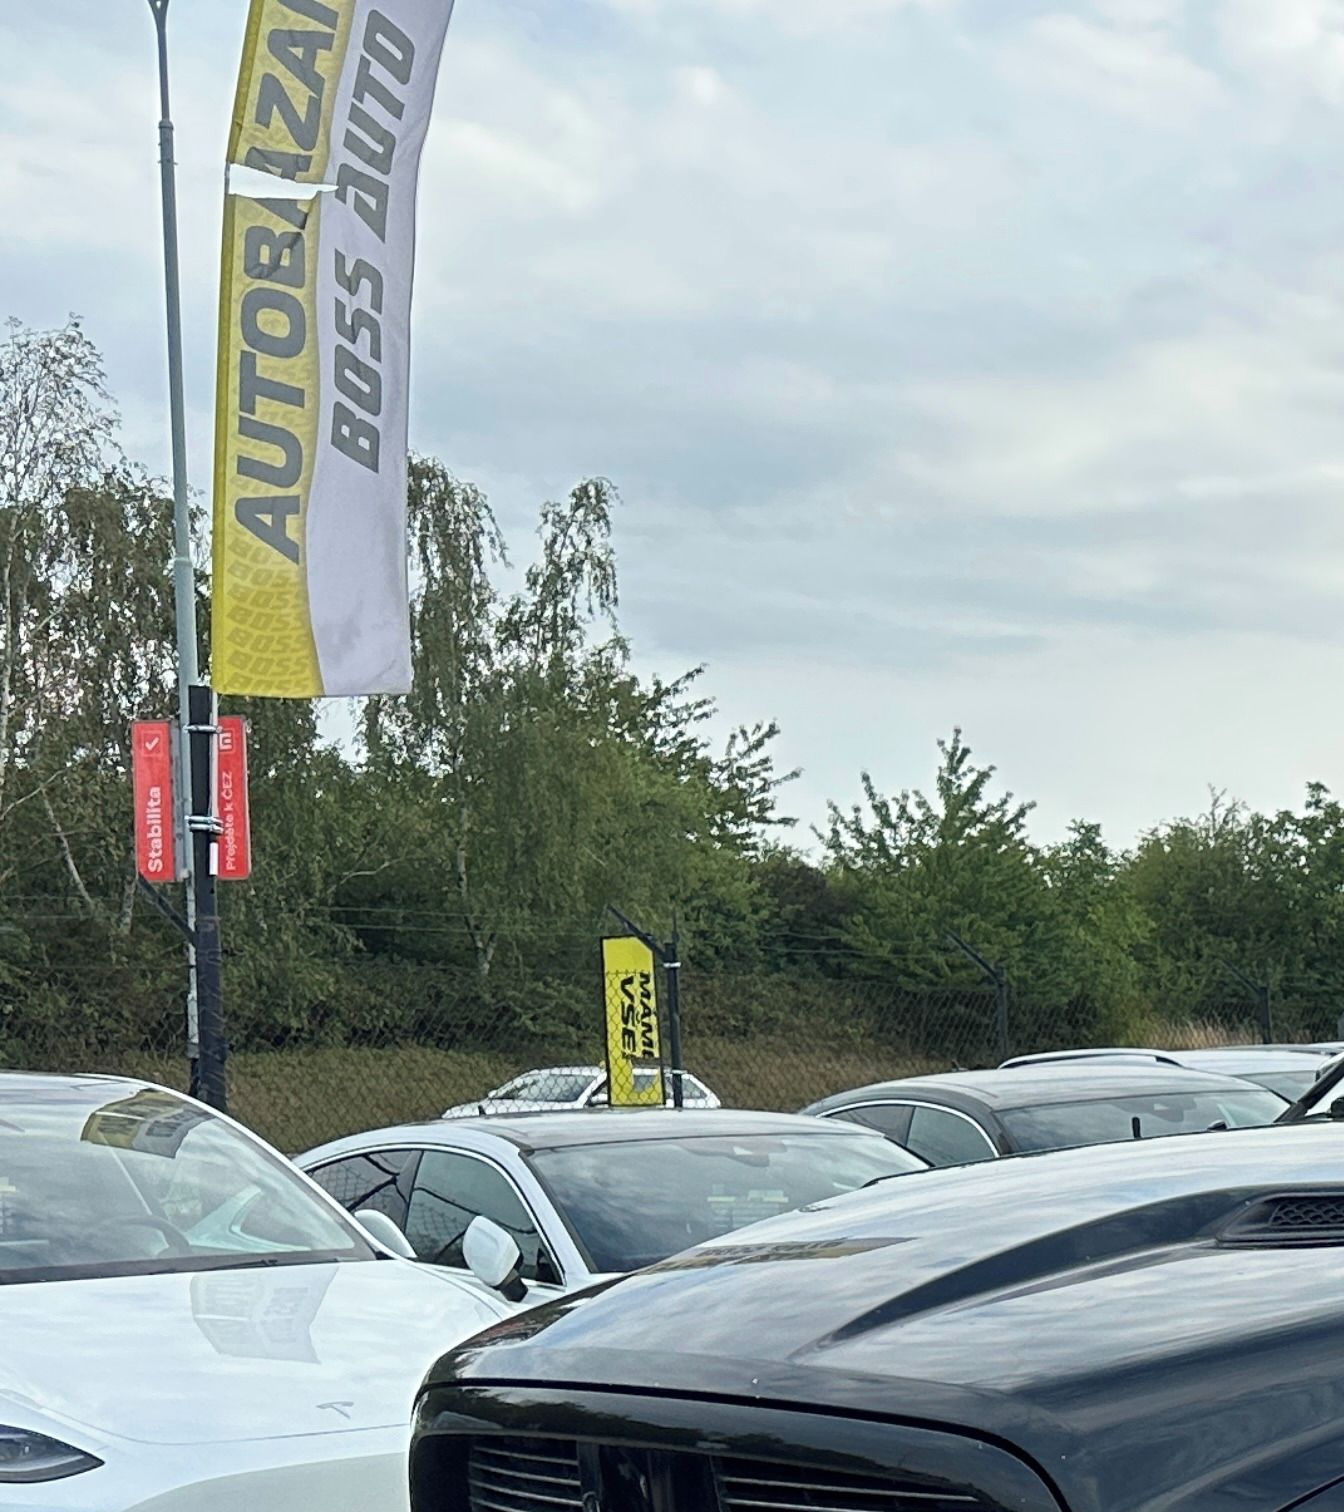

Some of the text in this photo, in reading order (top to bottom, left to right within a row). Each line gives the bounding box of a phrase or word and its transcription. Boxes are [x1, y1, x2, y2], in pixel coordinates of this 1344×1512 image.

[331, 9, 415, 475] BOSS AUTO
[221, 771, 233, 800] ČEZ
[145, 786, 163, 873] Stabilita
